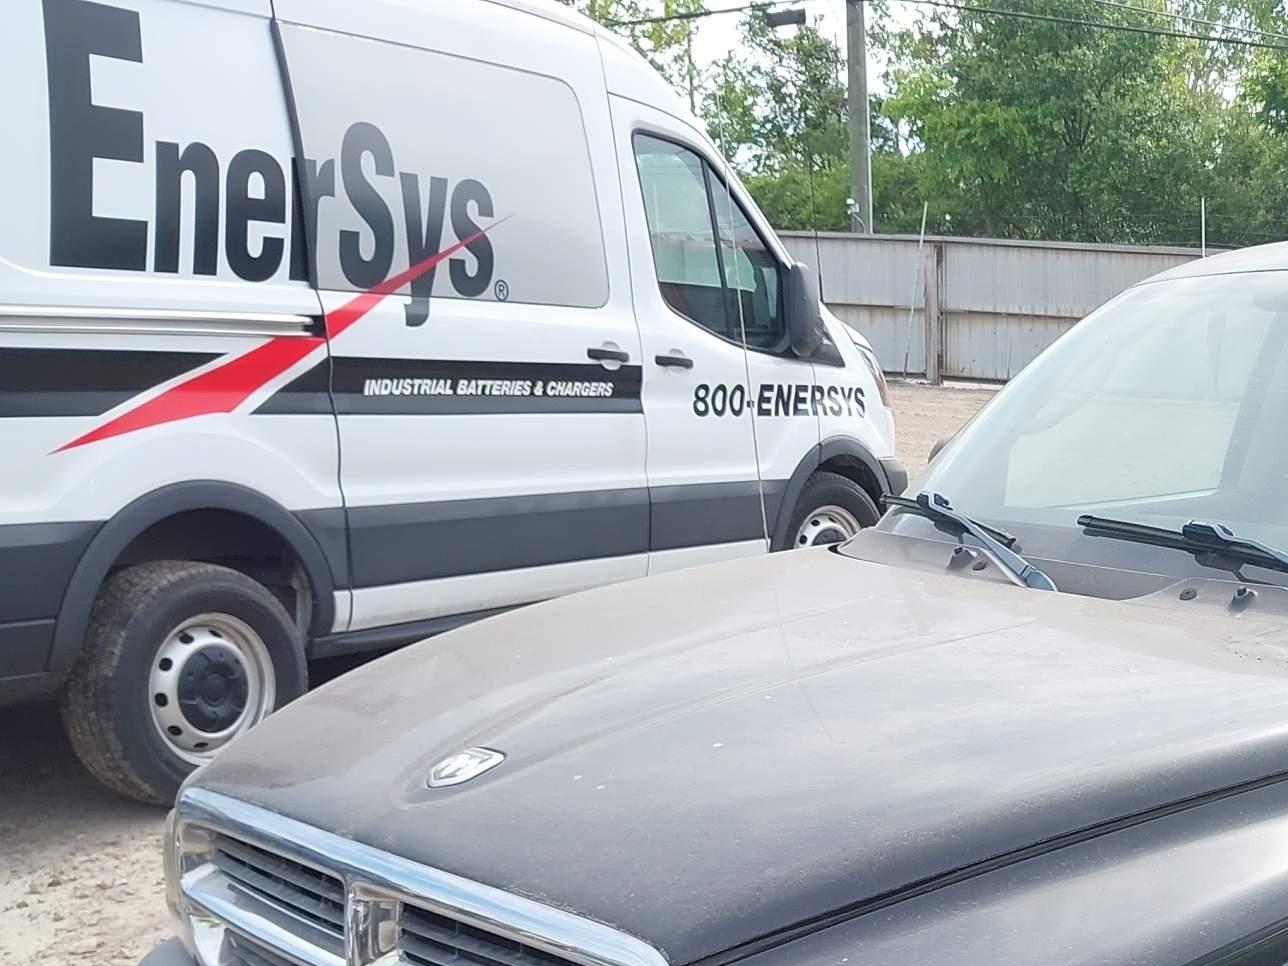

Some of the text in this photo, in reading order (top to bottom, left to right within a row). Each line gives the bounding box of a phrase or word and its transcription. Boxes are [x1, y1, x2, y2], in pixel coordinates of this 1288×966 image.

[43, 0, 495, 326] EnerSys
[363, 379, 614, 397] INDUSTRIAL BATTERIES & CHARGERS
[693, 383, 866, 419] 800-ENERSYS
